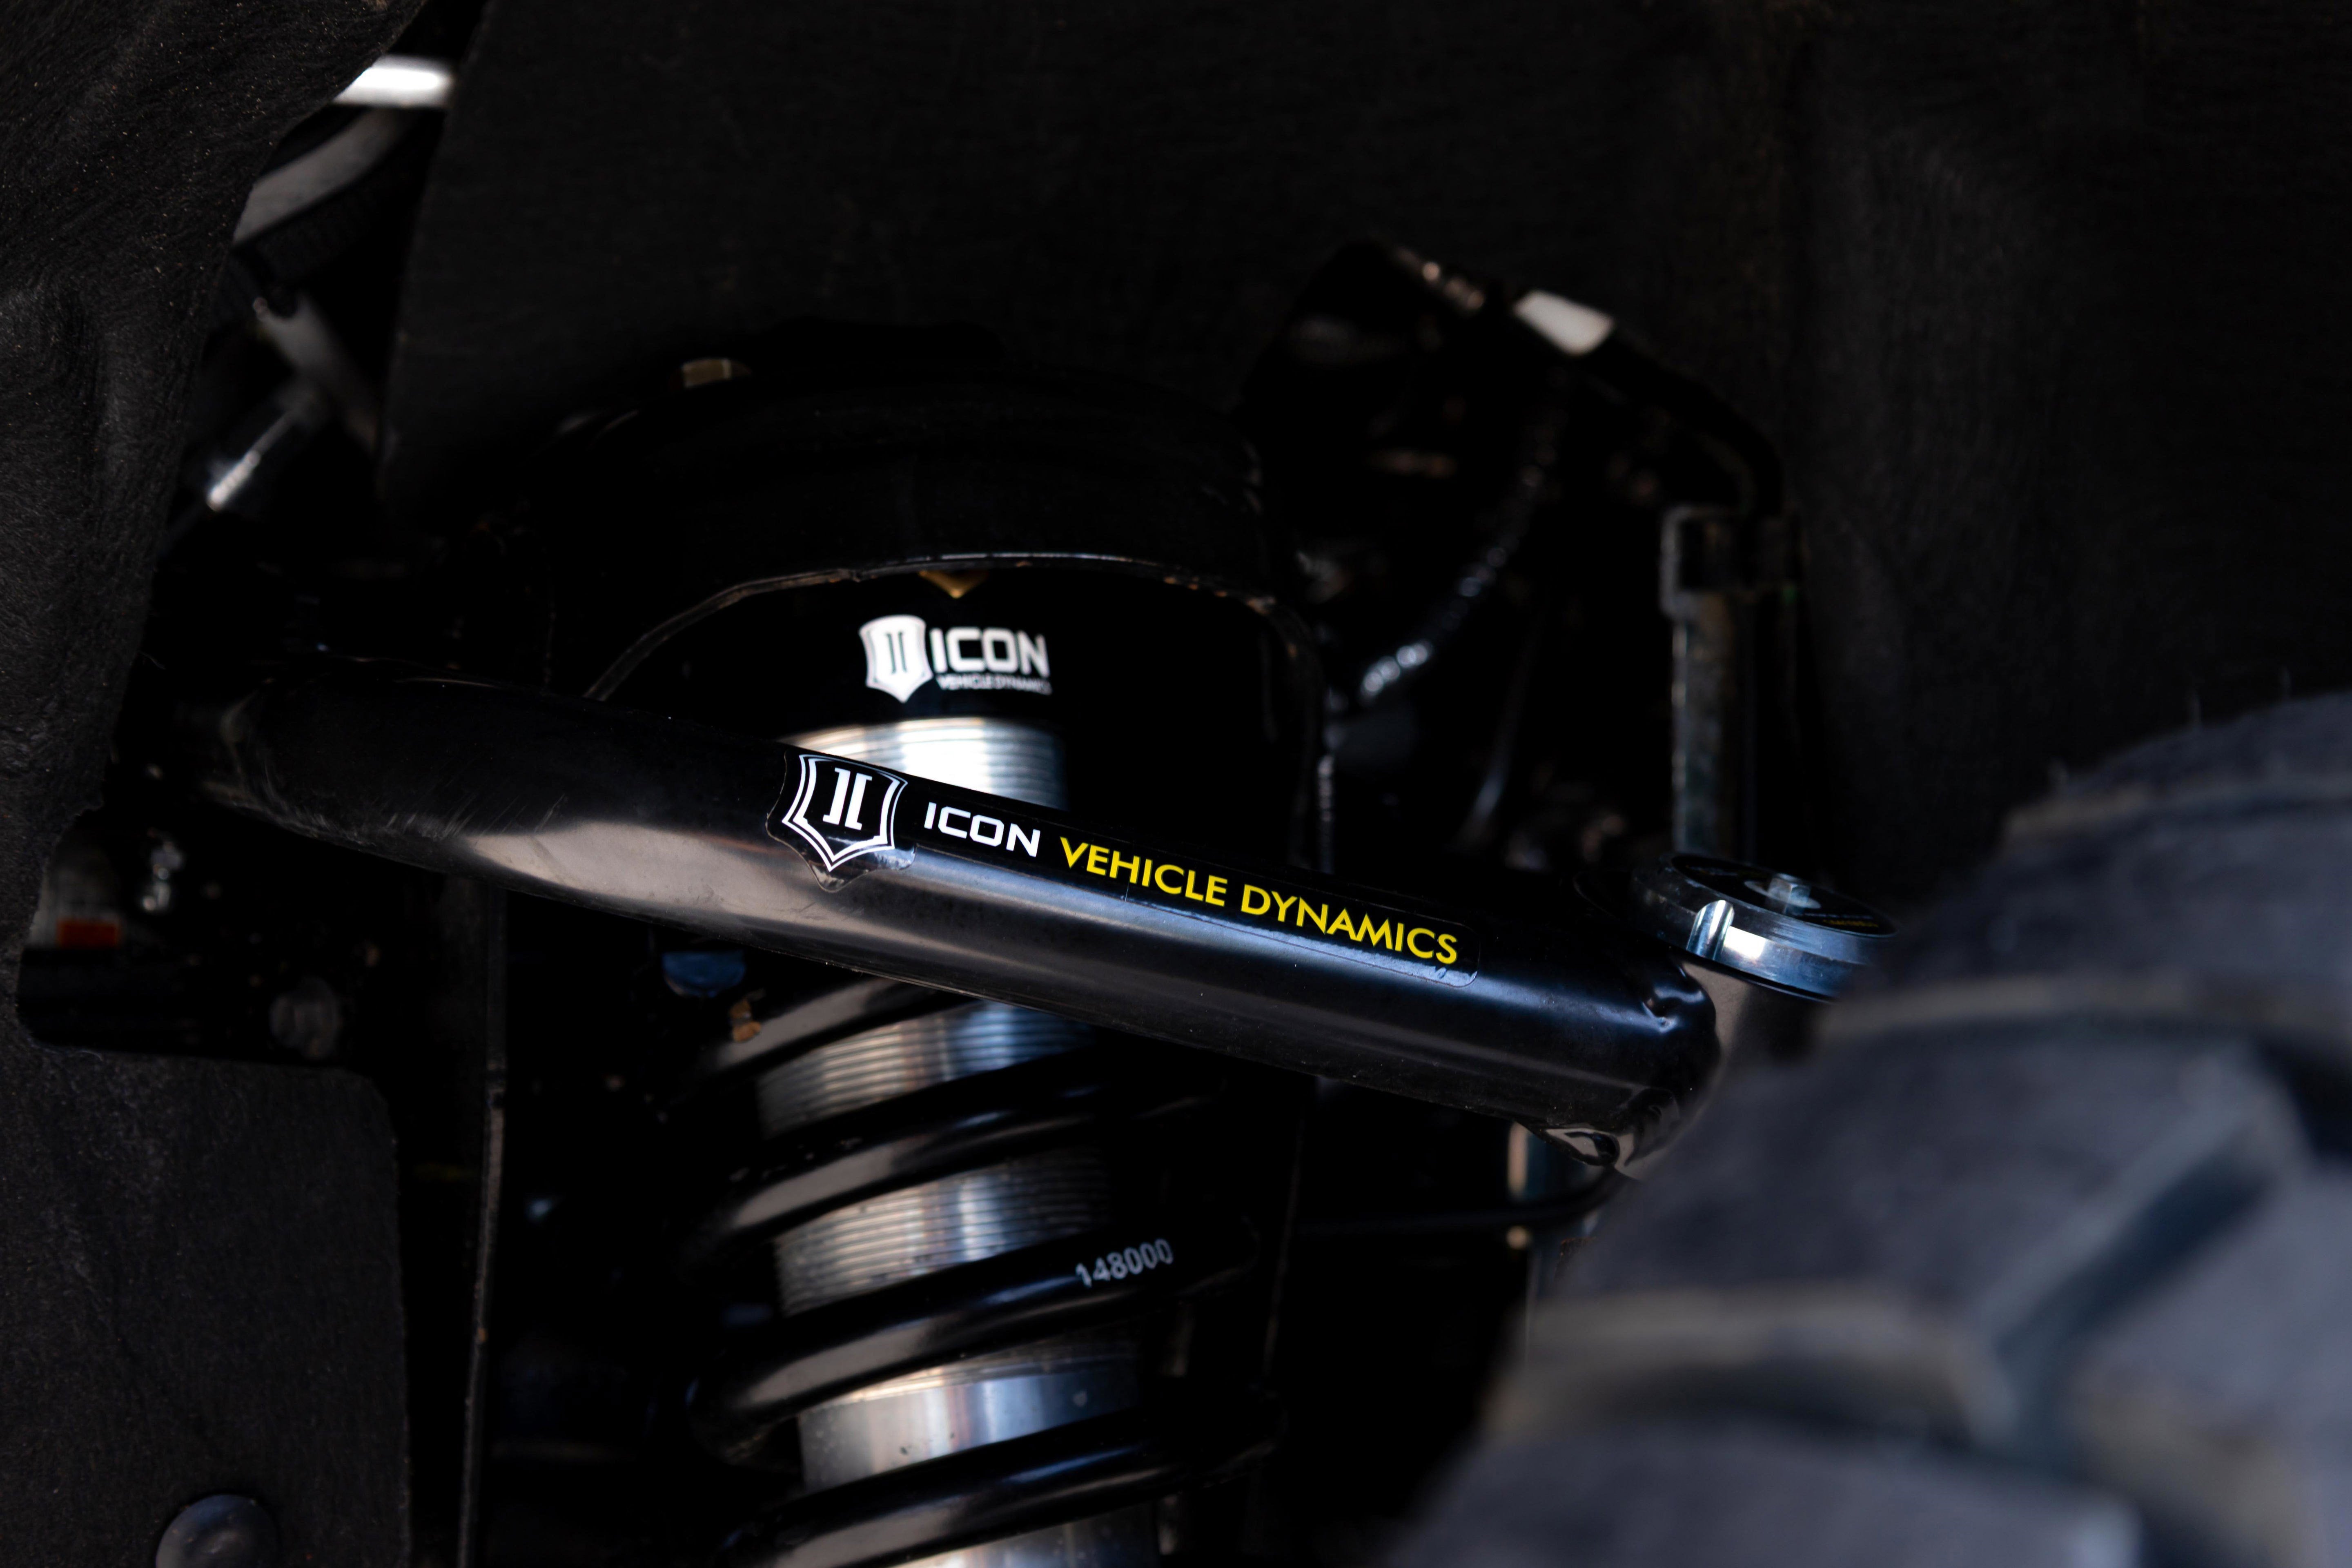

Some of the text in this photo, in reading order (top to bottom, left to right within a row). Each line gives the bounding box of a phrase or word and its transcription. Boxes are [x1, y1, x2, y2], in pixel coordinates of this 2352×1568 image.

[929, 627, 1050, 678] ICON
[924, 802, 1458, 965] ICON VEHICLE DYNAMICS
[1075, 1238, 1174, 1287] 148000
